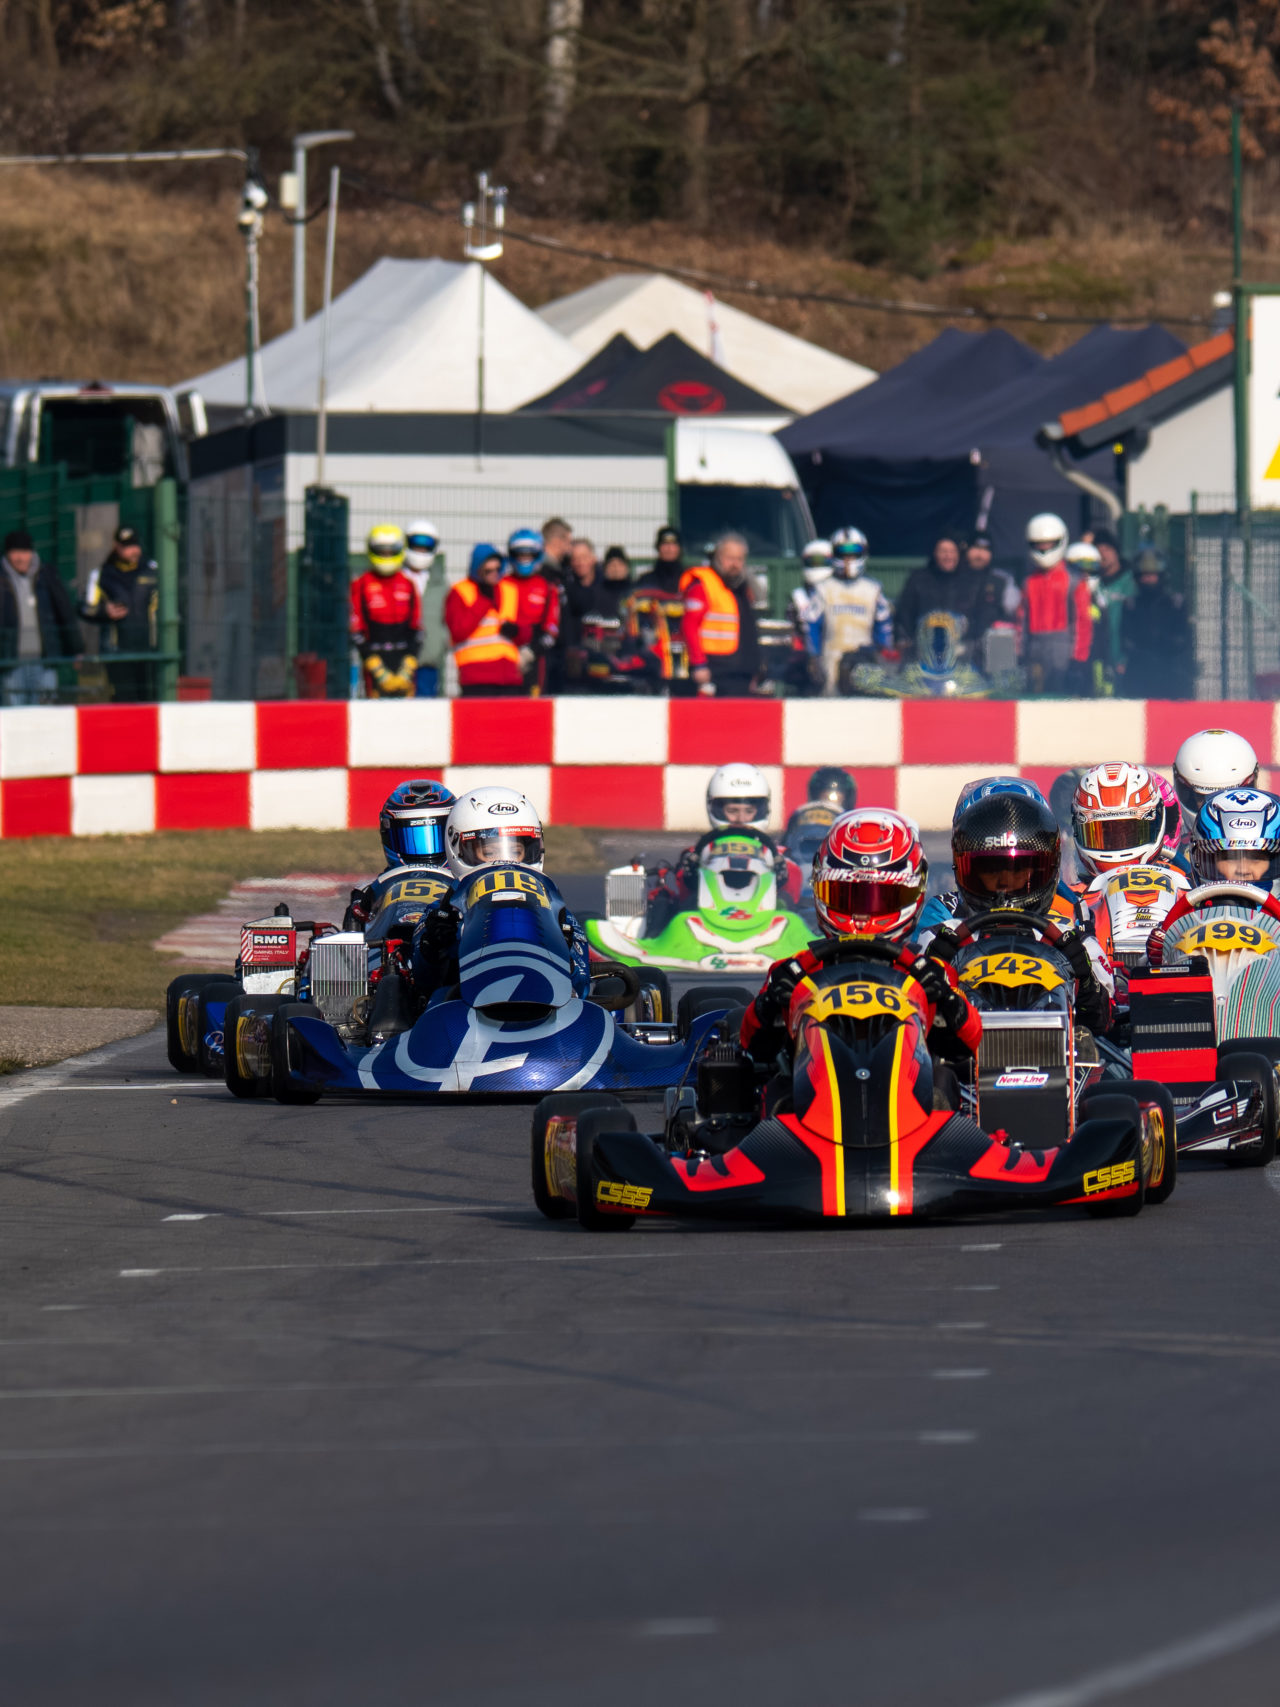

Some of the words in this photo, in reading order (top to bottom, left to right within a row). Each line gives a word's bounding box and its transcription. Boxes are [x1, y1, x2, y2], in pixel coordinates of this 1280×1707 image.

[410, 818, 436, 827] zamp
[478, 871, 545, 897] 119
[1110, 871, 1174, 893] 154
[253, 935, 288, 944] RMC
[1189, 922, 1263, 947] 199
[974, 956, 1043, 981] 142
[822, 984, 902, 1012] 156
